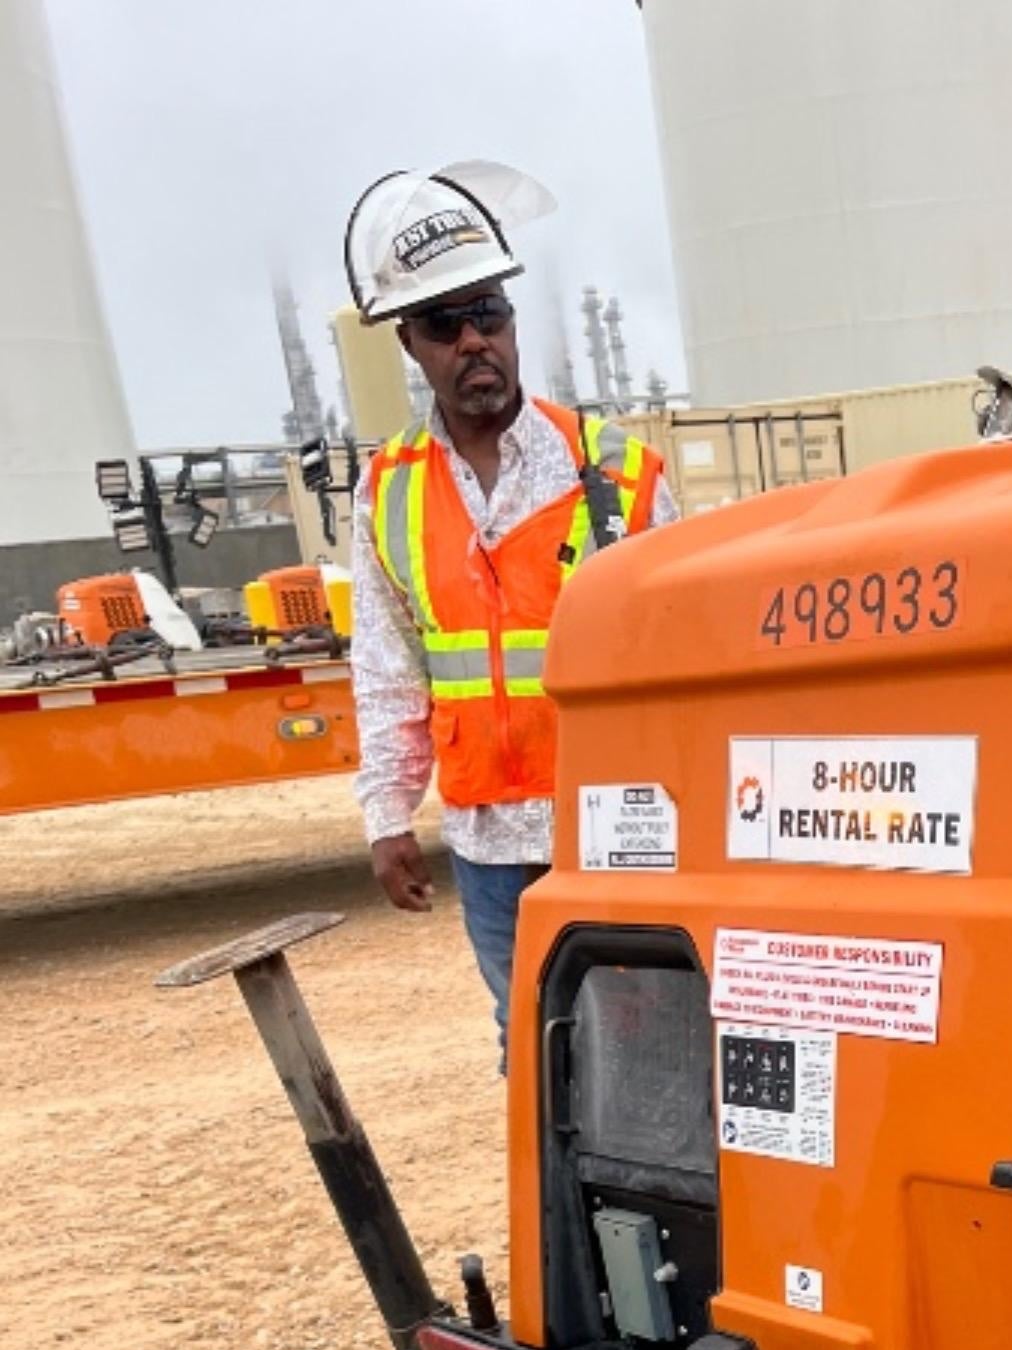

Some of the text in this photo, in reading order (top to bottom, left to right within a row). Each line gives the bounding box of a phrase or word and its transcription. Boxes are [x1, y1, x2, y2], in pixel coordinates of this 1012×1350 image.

[761, 561, 958, 645] 498933
[812, 761, 917, 793] 8-HOUR
[779, 808, 961, 847] RENTAL RATE
